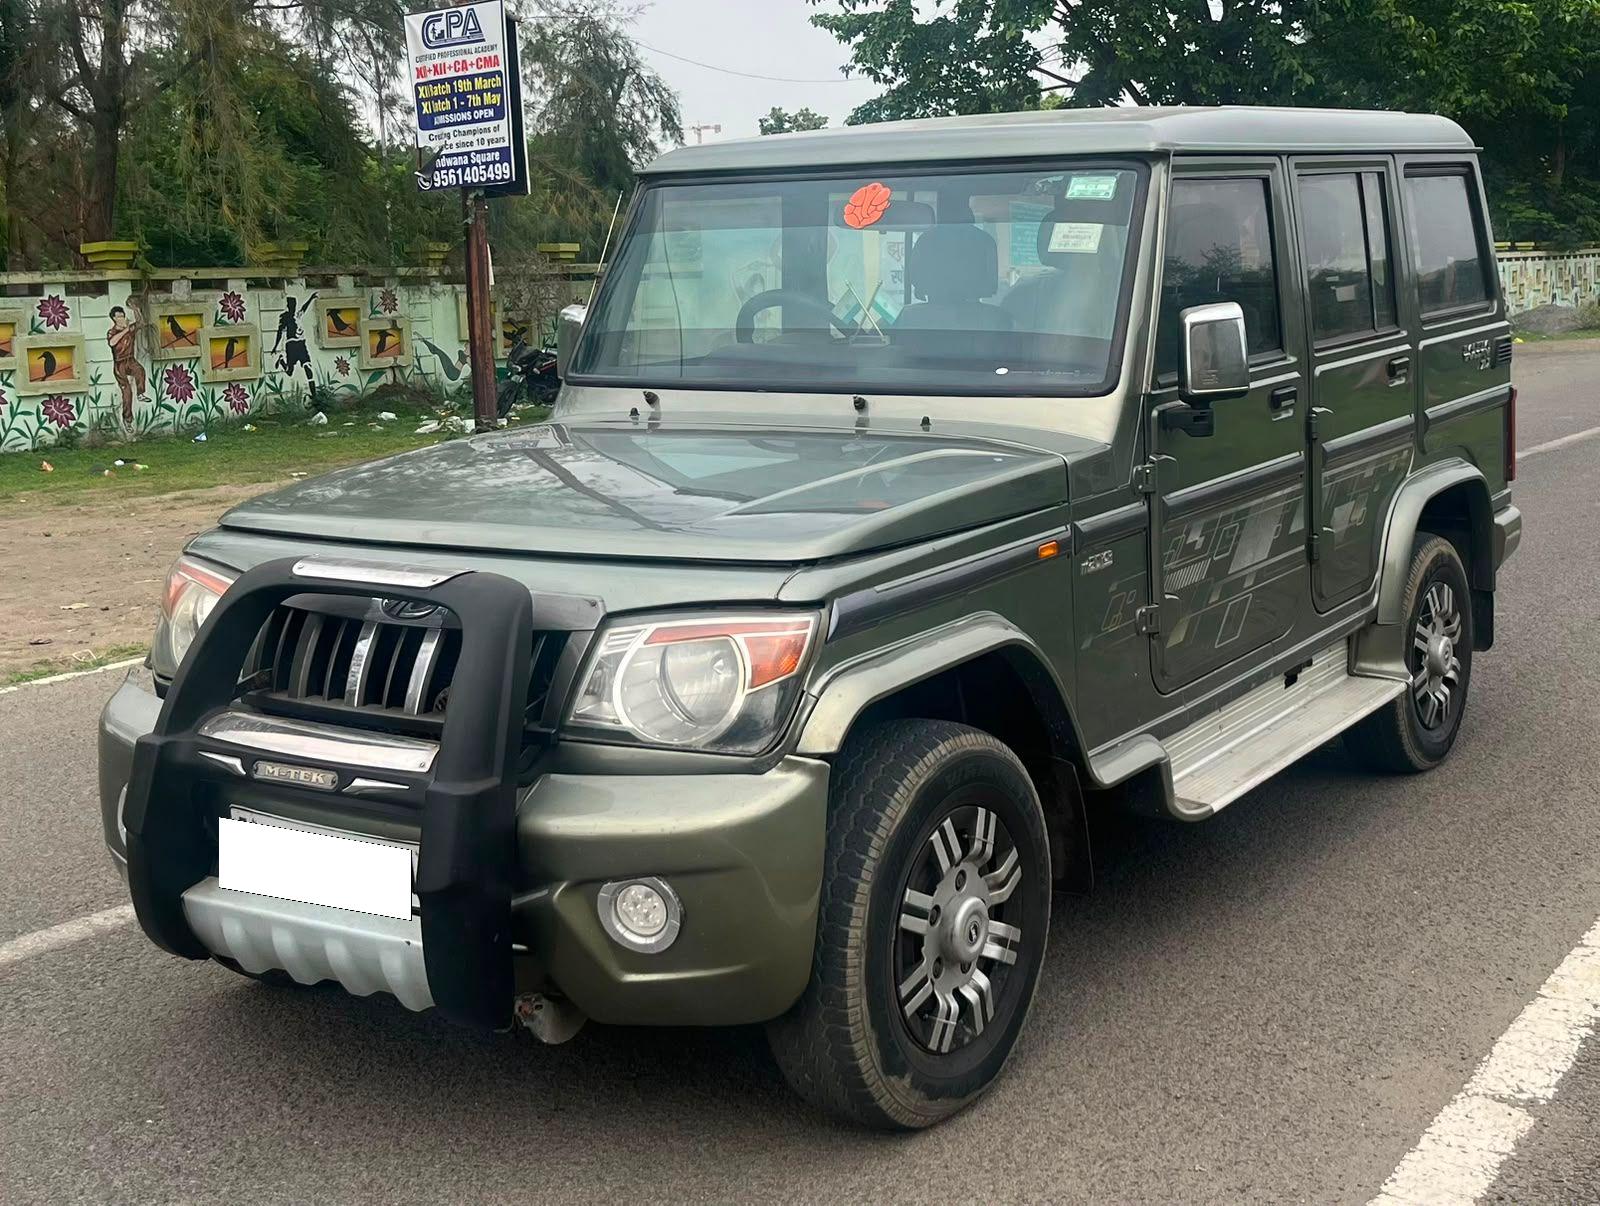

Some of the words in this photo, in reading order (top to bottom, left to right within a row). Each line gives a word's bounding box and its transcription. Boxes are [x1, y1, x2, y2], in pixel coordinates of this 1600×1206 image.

[437, 47, 474, 60] PROFESSIONAL
[475, 44, 498, 54] ACADEMY
[453, 79, 473, 93] 19th
[474, 75, 502, 90] March
[453, 97, 458, 109] 1
[466, 94, 482, 107] 7th
[483, 92, 501, 106] May
[473, 108, 494, 120] OPEN
[453, 126, 491, 138] Champions
[493, 124, 500, 133] of
[456, 139, 474, 150] since
[476, 138, 486, 146] 10
[487, 136, 506, 147] years
[470, 151, 500, 165] Square
[433, 162, 511, 187] 9561405499
[265, 765, 326, 784] M-TEK
